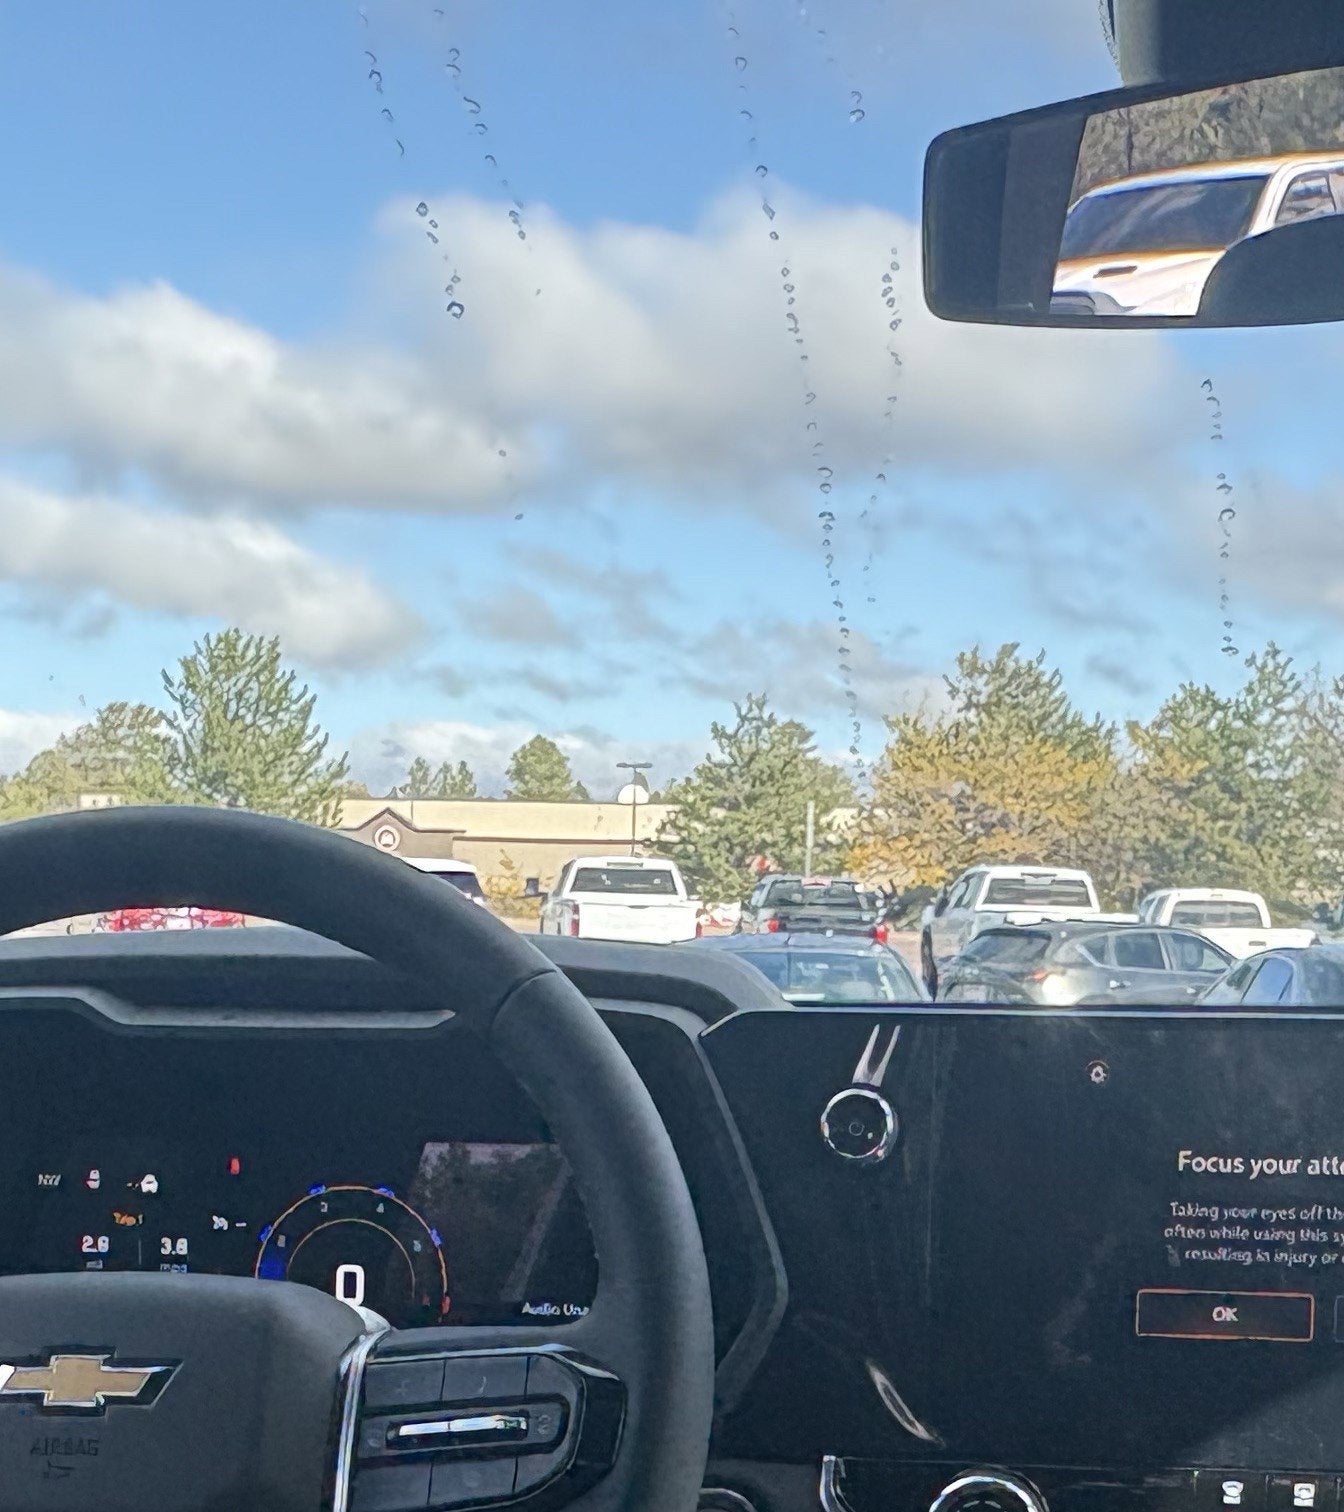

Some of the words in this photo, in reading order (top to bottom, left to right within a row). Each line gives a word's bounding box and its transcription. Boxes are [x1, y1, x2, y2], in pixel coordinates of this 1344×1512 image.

[1178, 1150, 1244, 1173] Focus
[1249, 1158, 1302, 1180] your
[1170, 1201, 1219, 1221] Taking
[1223, 1206, 1257, 1220] your
[1261, 1207, 1296, 1222] eyes
[1300, 1203, 1322, 1220] off
[1164, 1224, 1206, 1239] often
[1210, 1225, 1249, 1240] while
[1253, 1227, 1296, 1245] using
[1300, 1228, 1329, 1242] this
[1185, 1247, 1253, 1265] resulting
[1256, 1249, 1270, 1263] in
[1274, 1249, 1317, 1268] injury
[1321, 1252, 1338, 1265] or
[335, 1263, 365, 1306] 0
[1212, 1306, 1238, 1322] OK
[30, 1437, 100, 1456] AIRBAG
